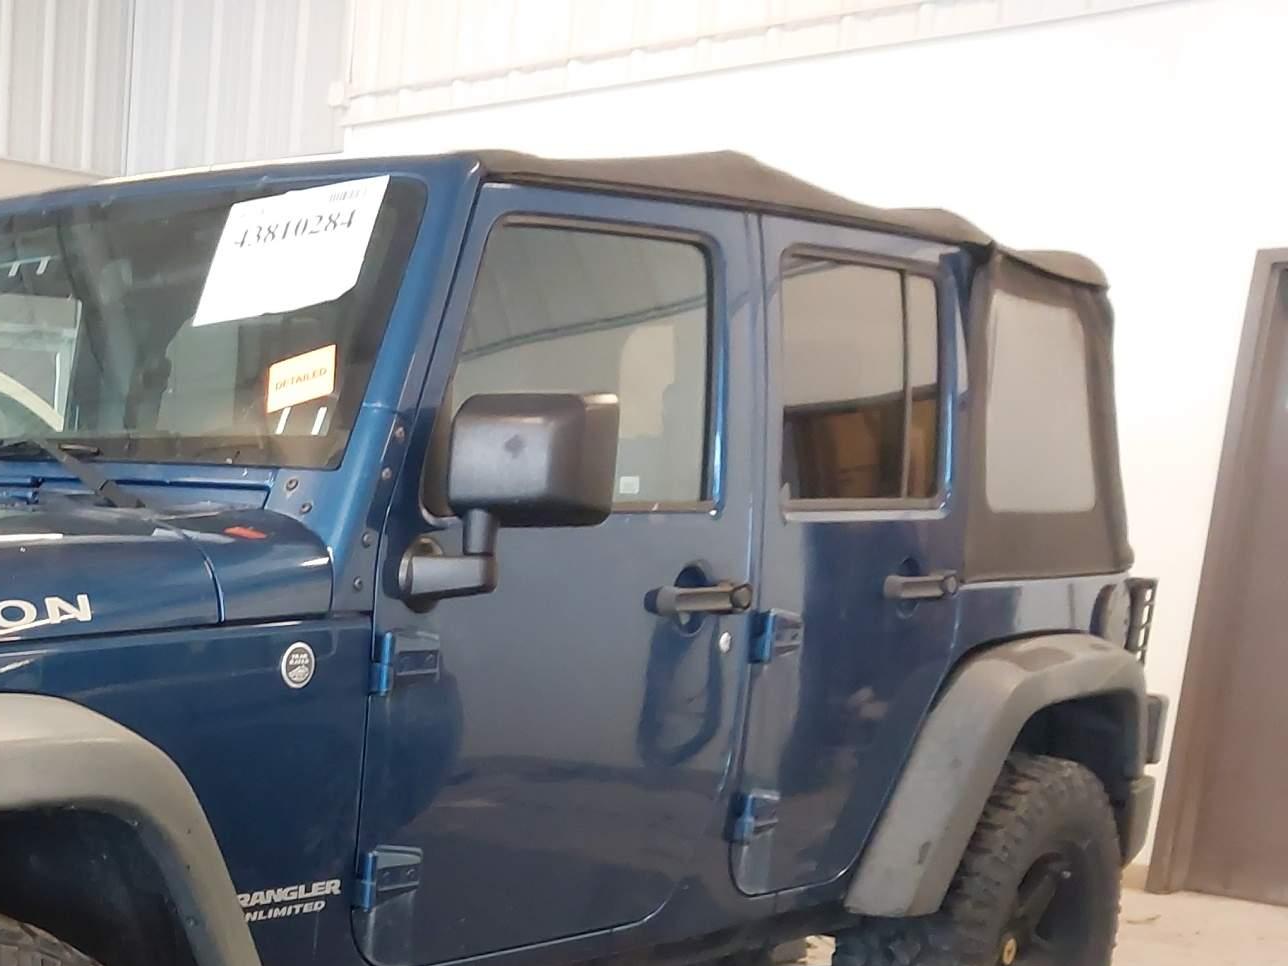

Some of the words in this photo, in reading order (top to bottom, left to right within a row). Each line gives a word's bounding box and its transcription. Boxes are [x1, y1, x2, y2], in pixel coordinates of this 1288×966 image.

[234, 209, 356, 248] 43810284
[275, 368, 327, 392] DETAILED
[237, 879, 341, 908] RANGLER
[245, 900, 326, 922] NLIMITED
